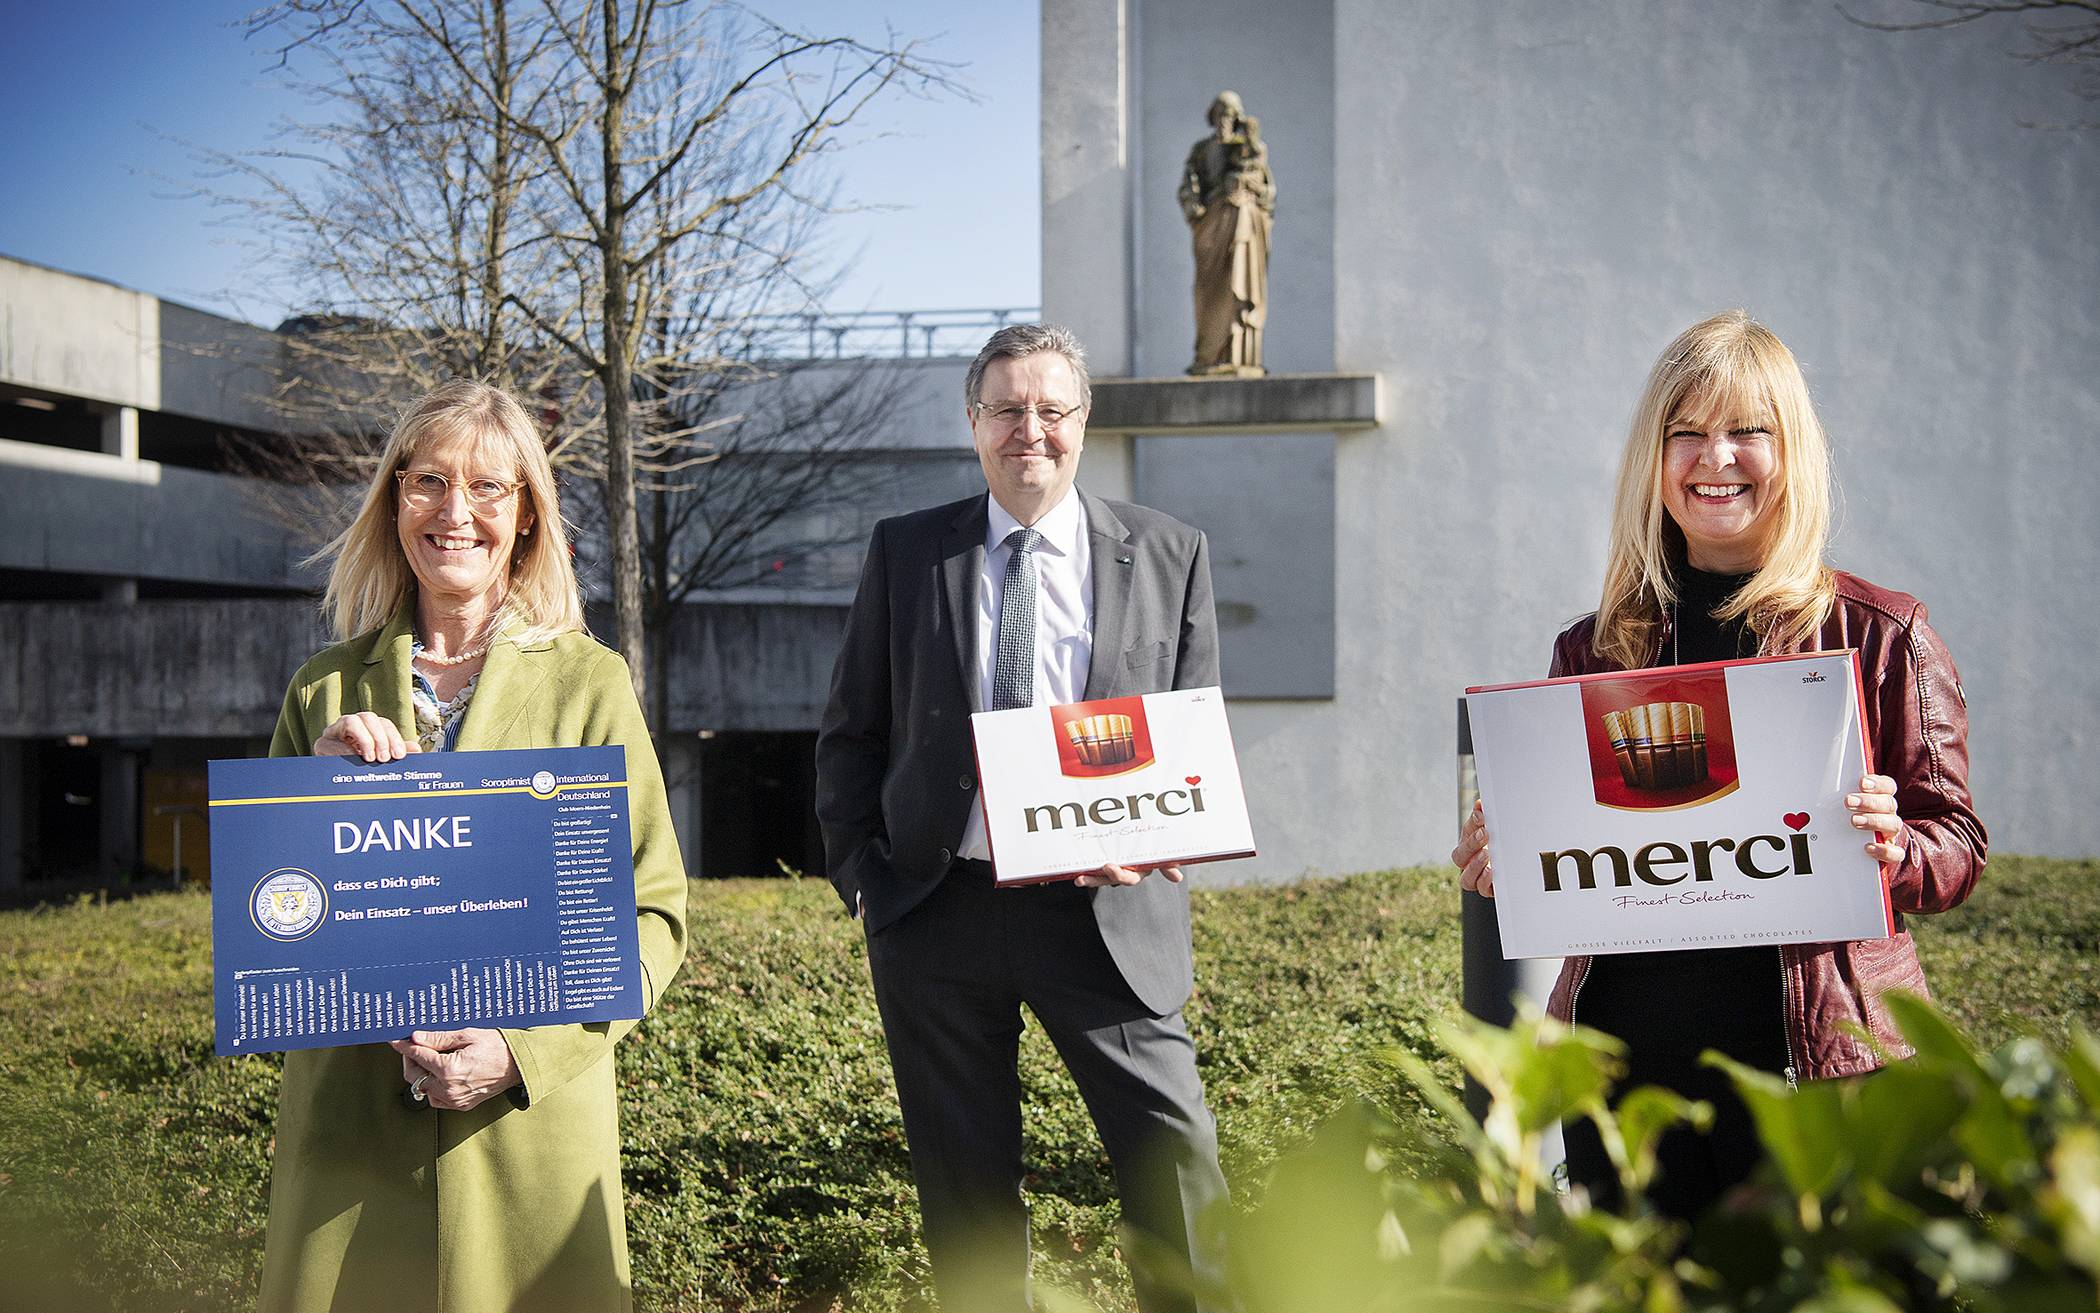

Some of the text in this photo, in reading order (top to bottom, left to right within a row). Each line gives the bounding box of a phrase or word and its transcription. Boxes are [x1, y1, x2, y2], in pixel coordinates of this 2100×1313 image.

[1802, 676, 1826, 684] STORCK
[332, 771, 442, 783] eine weltweite Stimme
[418, 780, 464, 790] für Frauen
[481, 773, 609, 788] Soroptimist International
[557, 790, 610, 801] Deutschland
[1023, 776, 1205, 833] merci
[333, 816, 472, 854] DANKE
[1538, 811, 1814, 892] merci
[333, 875, 440, 891] dass es Dich gibt;
[1612, 889, 1755, 909] Finest Selection
[334, 909, 364, 921] Dein
[366, 907, 411, 918] Einsatz
[423, 904, 458, 915] unser
[1613, 938, 1663, 946] VIELFALT
[1681, 934, 1735, 942] ASSORTED
[1743, 929, 1813, 938] CHOCOLATES
